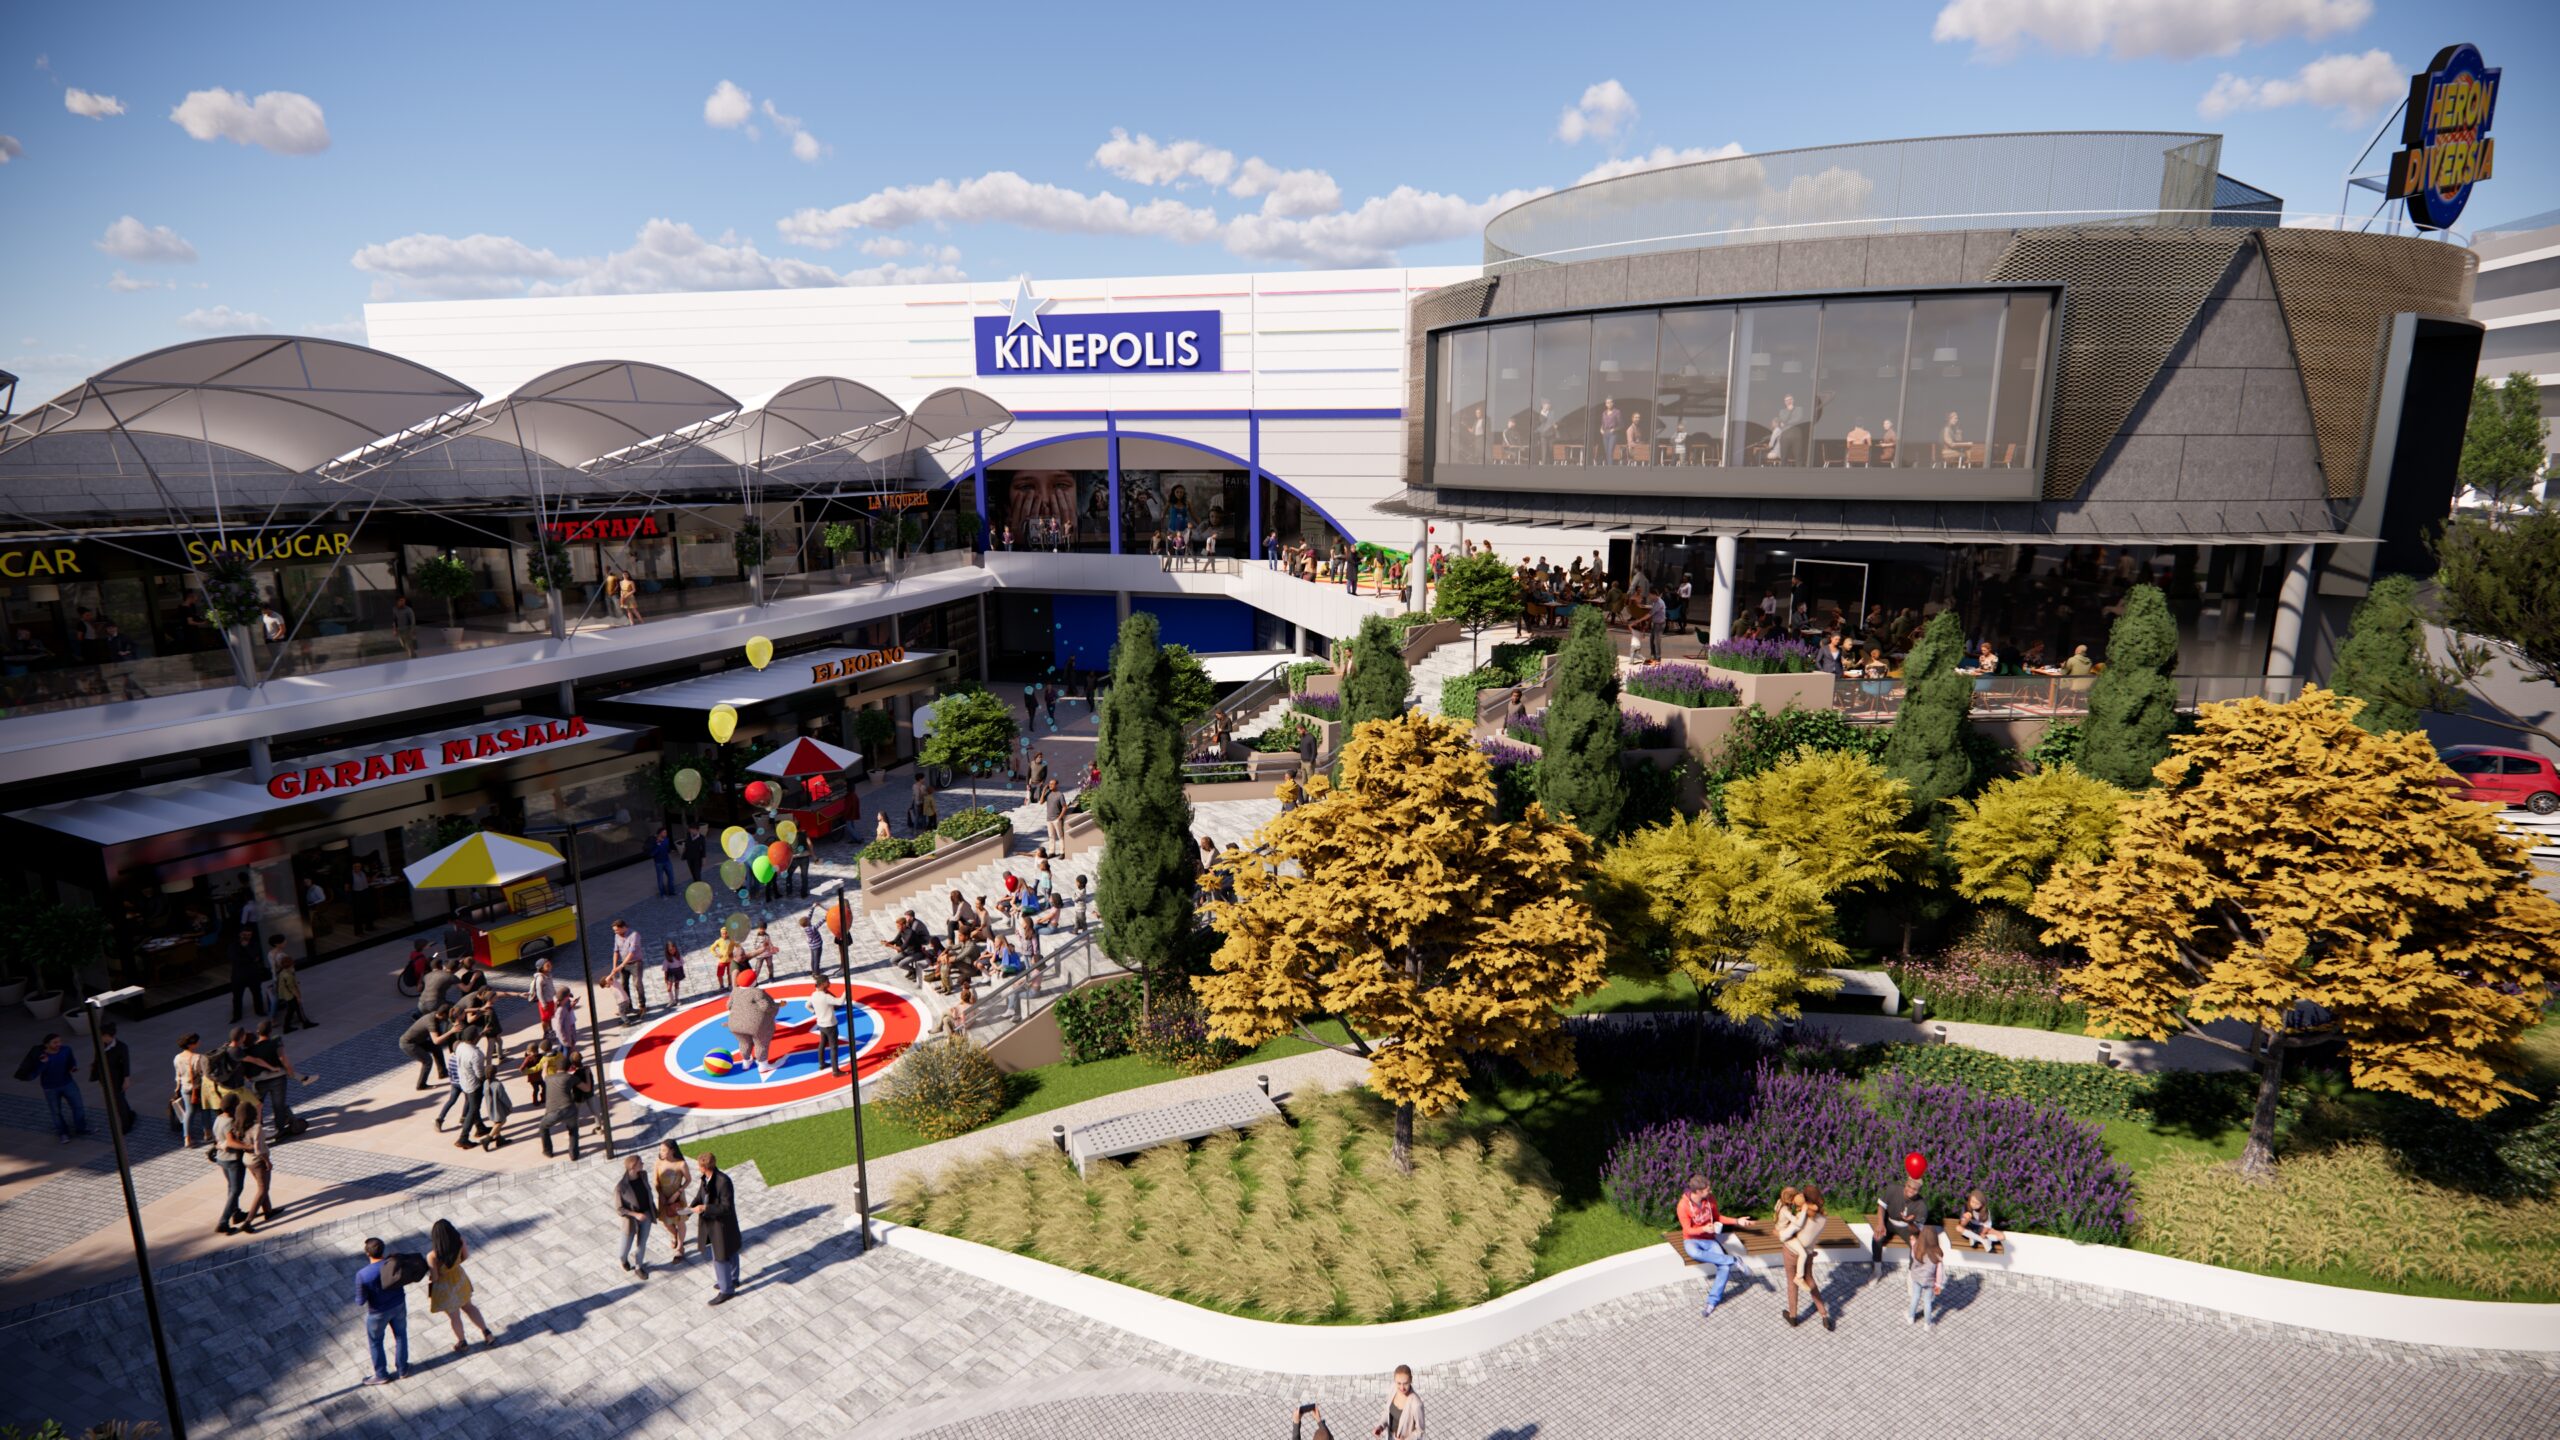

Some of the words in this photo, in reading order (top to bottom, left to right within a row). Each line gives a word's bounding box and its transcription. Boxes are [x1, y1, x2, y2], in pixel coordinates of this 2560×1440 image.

[2428, 80, 2495, 130] HERON
[2403, 139, 2494, 196] DIVERSIA
[995, 330, 1199, 369] KINEPOLIS
[868, 496, 881, 510] LA
[811, 662, 840, 684] EL
[841, 646, 905, 676] HORNO
[267, 748, 429, 799] GARAM
[441, 715, 590, 765] MASALA
